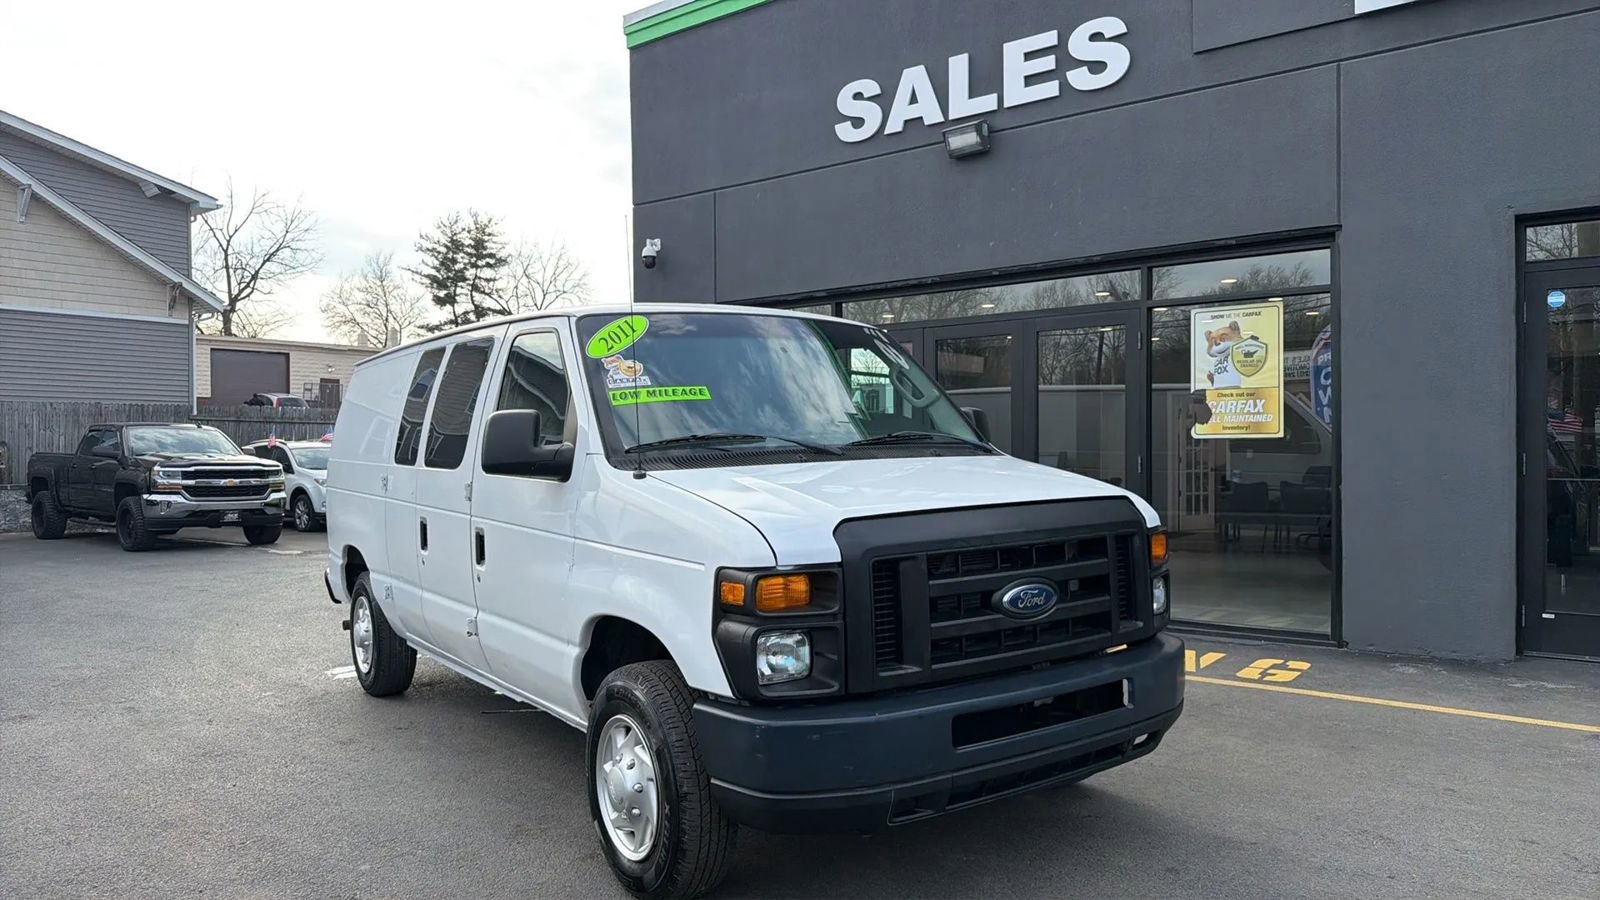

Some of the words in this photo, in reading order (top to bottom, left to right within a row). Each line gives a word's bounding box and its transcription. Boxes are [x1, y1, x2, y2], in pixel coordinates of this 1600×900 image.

[834, 16, 1131, 143] SALES
[598, 319, 637, 352] 2011
[1214, 365, 1229, 375] FOX
[611, 389, 641, 401] LOW
[646, 387, 707, 399] MILEAGE
[1207, 399, 1266, 414] CARFAX
[1223, 413, 1273, 424] MAINTAINED
[1018, 589, 1046, 608] Ford
